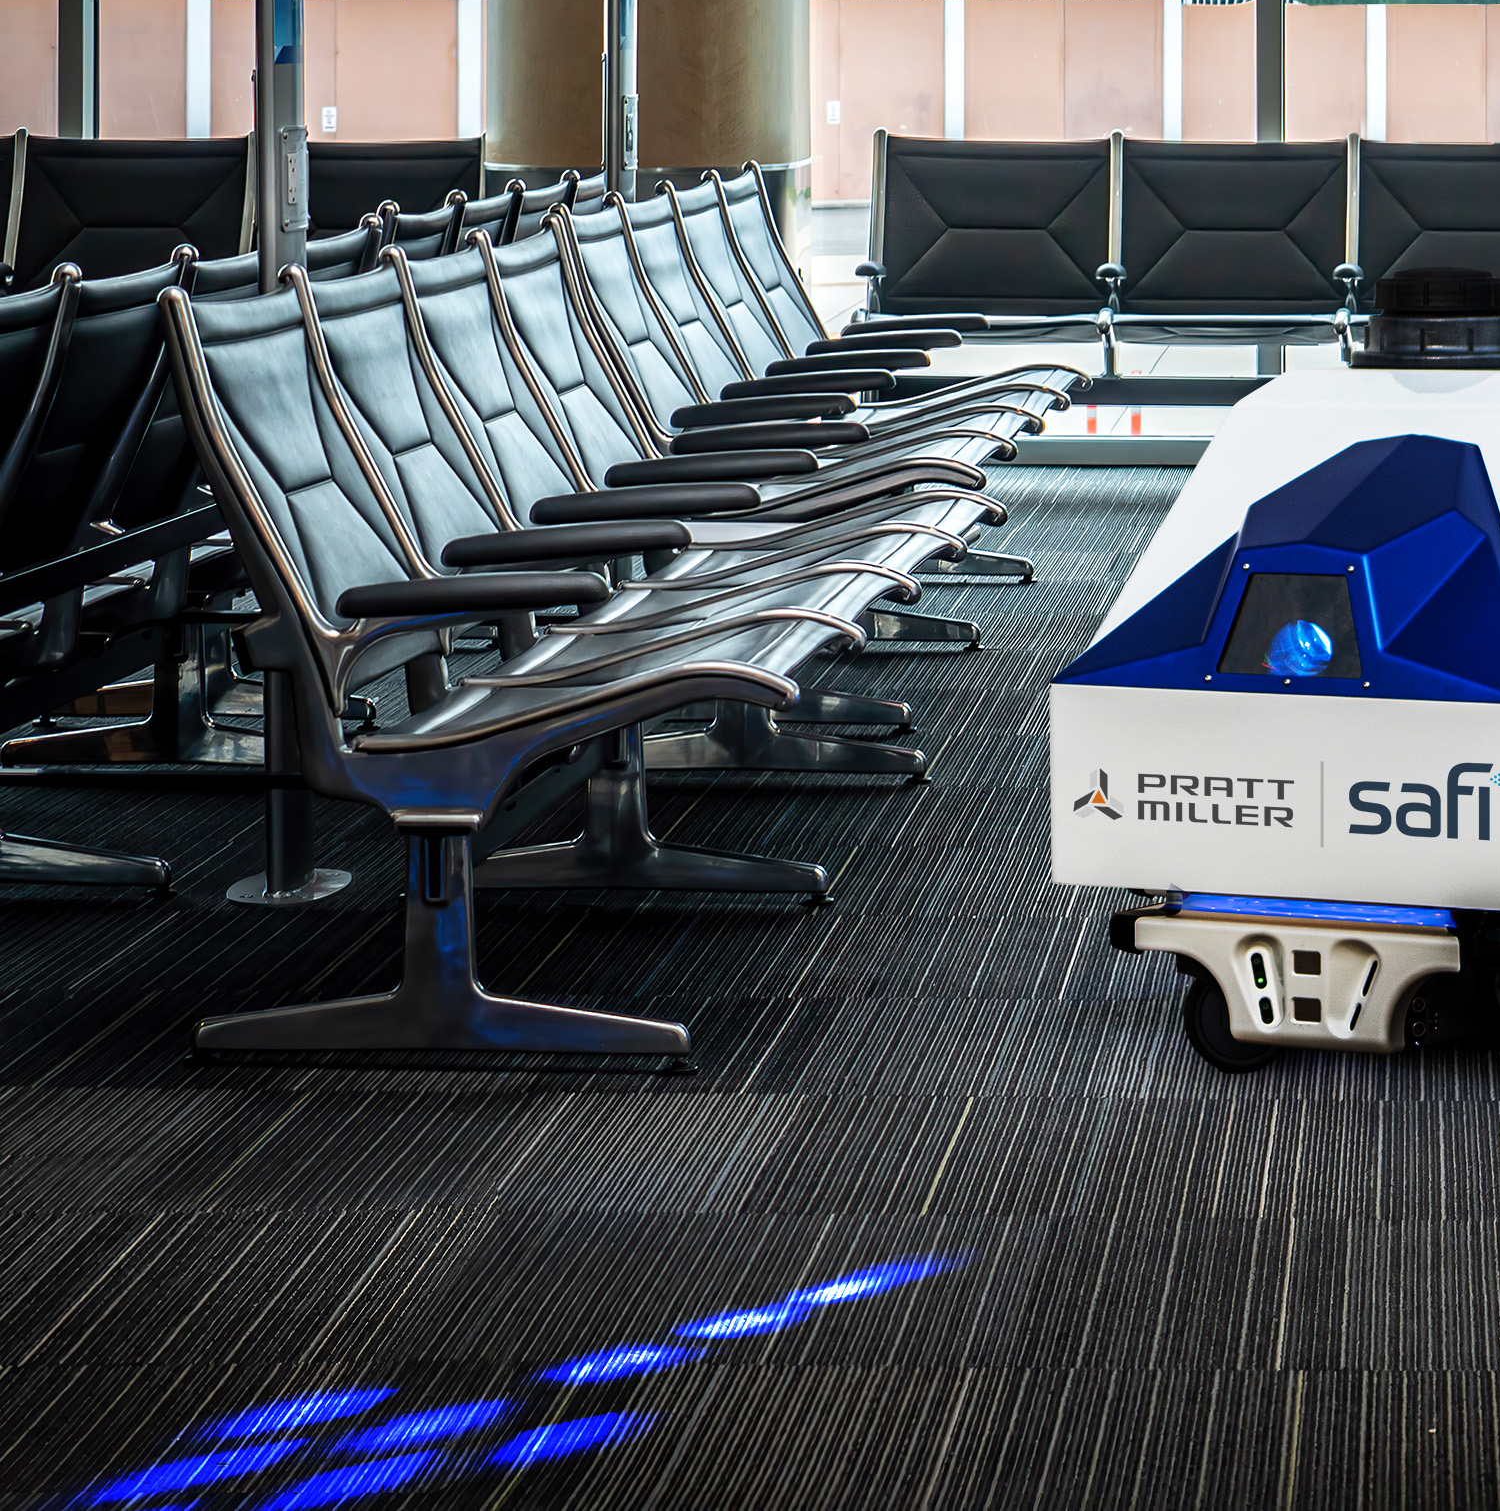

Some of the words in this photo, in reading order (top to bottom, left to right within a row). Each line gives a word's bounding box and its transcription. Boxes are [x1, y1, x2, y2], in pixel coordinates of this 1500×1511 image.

[1137, 773, 1295, 801] PRATT
[1348, 762, 1494, 841] safi
[1137, 799, 1295, 828] MILLER
